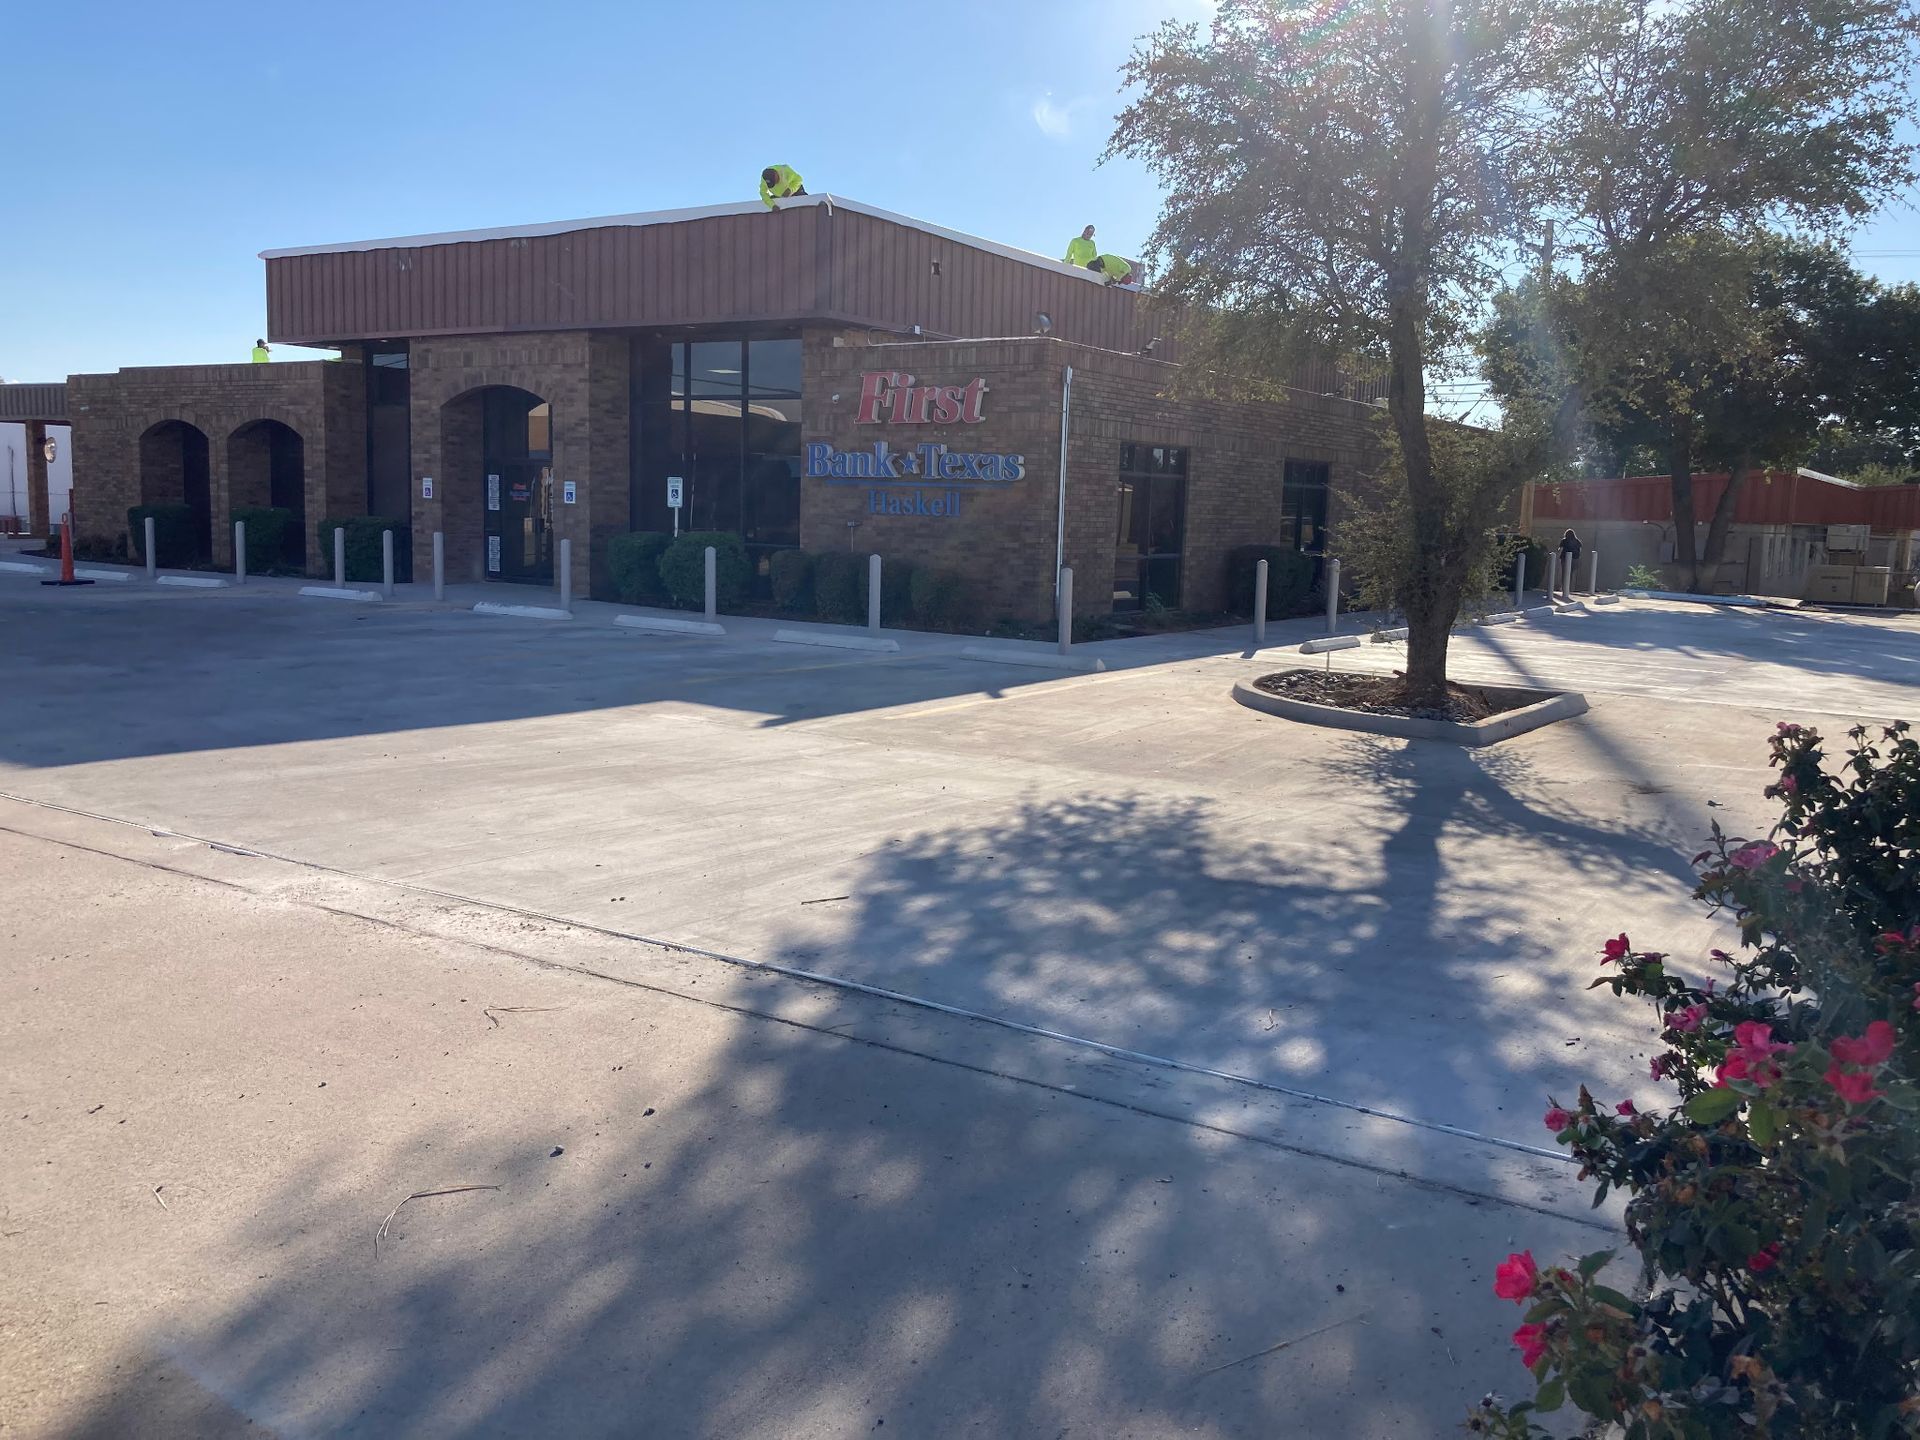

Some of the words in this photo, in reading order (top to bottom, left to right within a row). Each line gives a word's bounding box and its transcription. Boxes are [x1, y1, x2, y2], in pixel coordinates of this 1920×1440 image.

[854, 371, 990, 424] First
[806, 441, 901, 478] Bank
[917, 442, 1025, 481] Texas
[868, 490, 961, 517] Haskell
